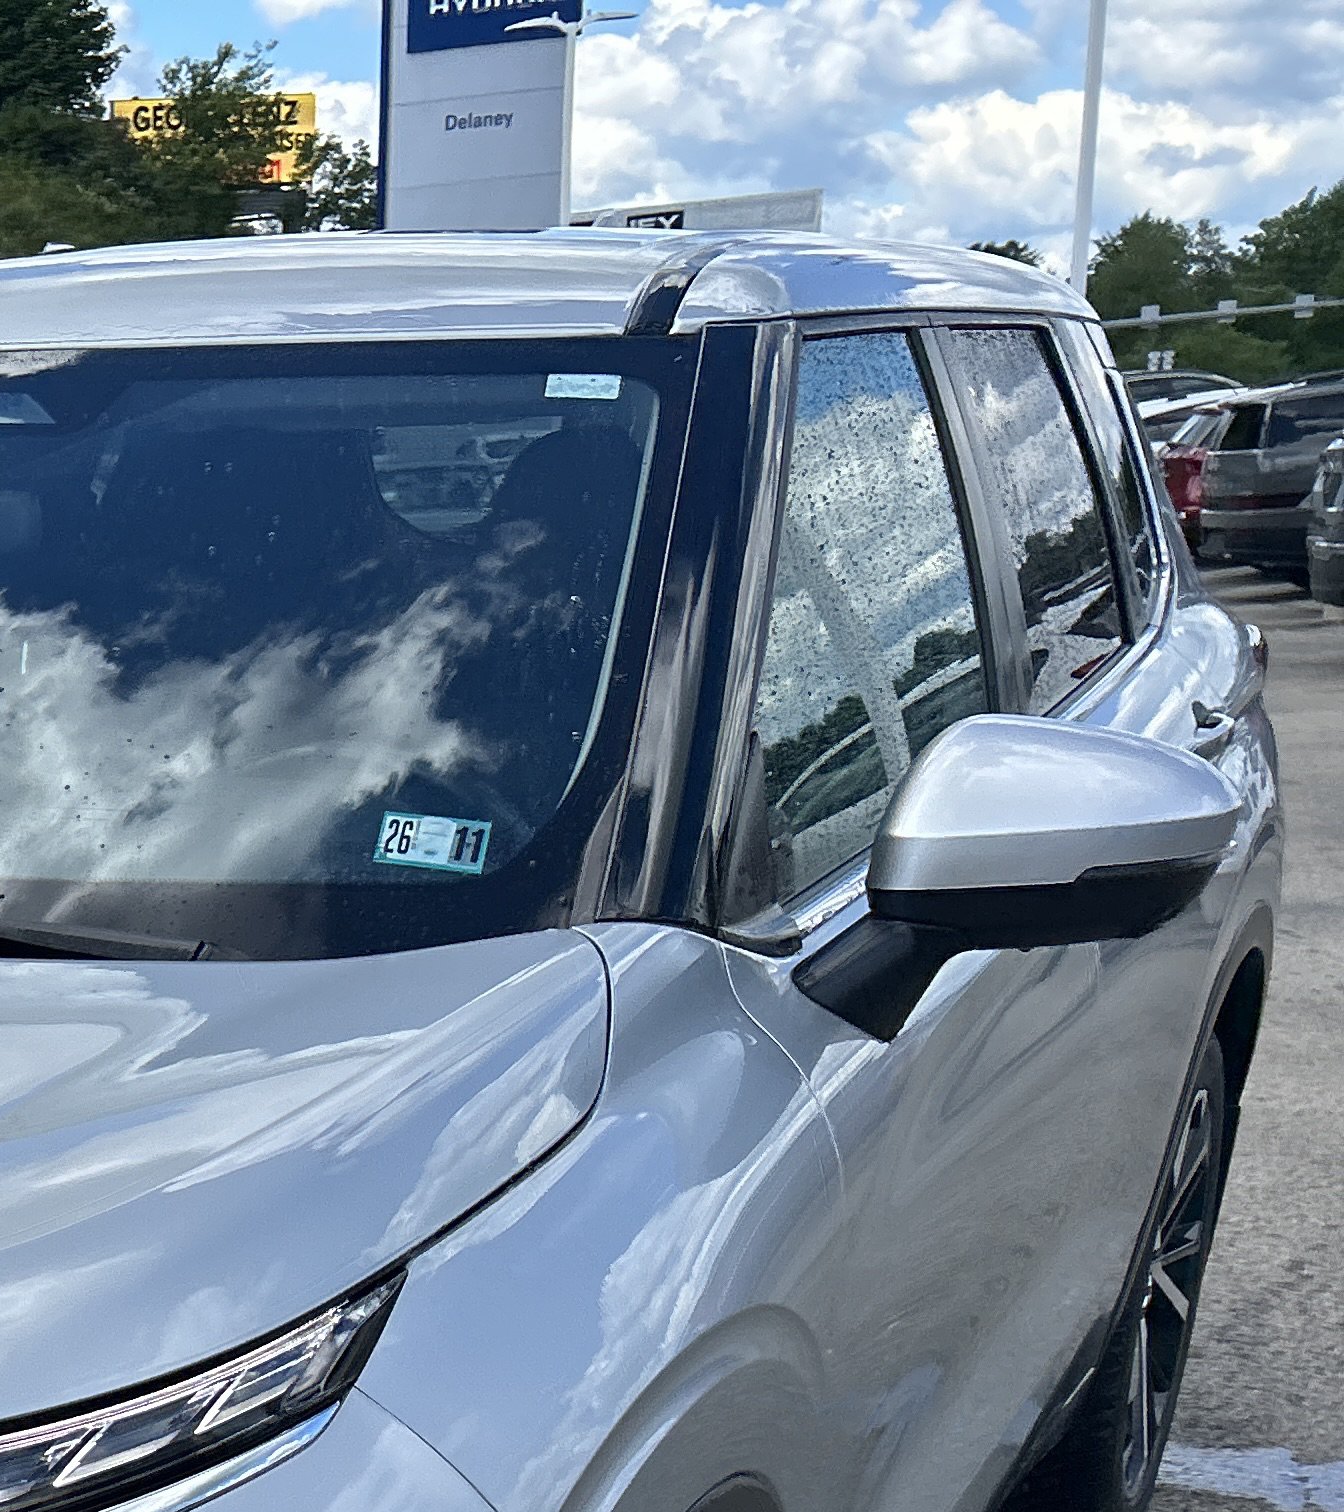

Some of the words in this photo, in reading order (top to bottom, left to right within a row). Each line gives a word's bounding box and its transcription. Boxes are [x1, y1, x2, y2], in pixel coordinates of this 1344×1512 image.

[445, 112, 514, 131] Delaney
[383, 818, 414, 855] 26
[453, 825, 486, 864] 11
